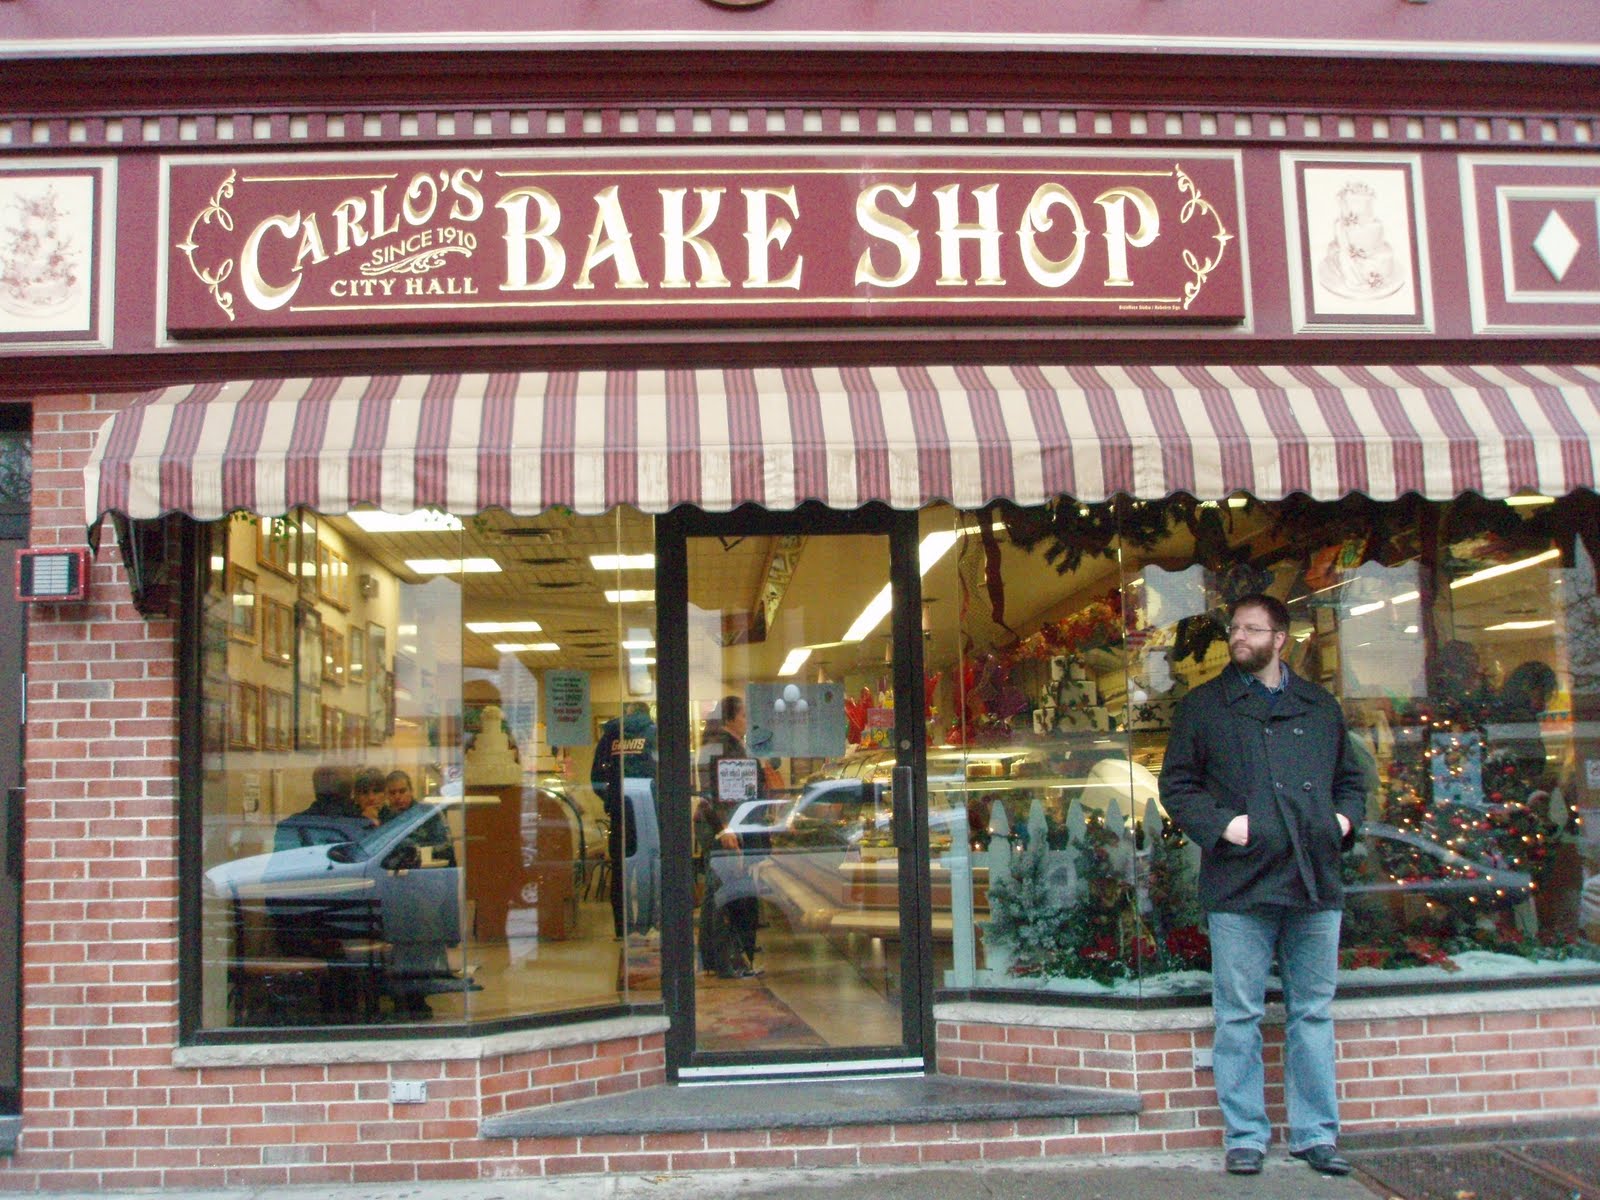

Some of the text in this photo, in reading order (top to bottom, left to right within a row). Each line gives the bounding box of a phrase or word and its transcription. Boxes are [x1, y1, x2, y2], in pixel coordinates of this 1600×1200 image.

[240, 168, 485, 311] CARLO'S
[371, 226, 478, 265] SINCE 1910
[494, 181, 1161, 292] BAKE SHOP
[330, 277, 479, 298] CITY HALL
